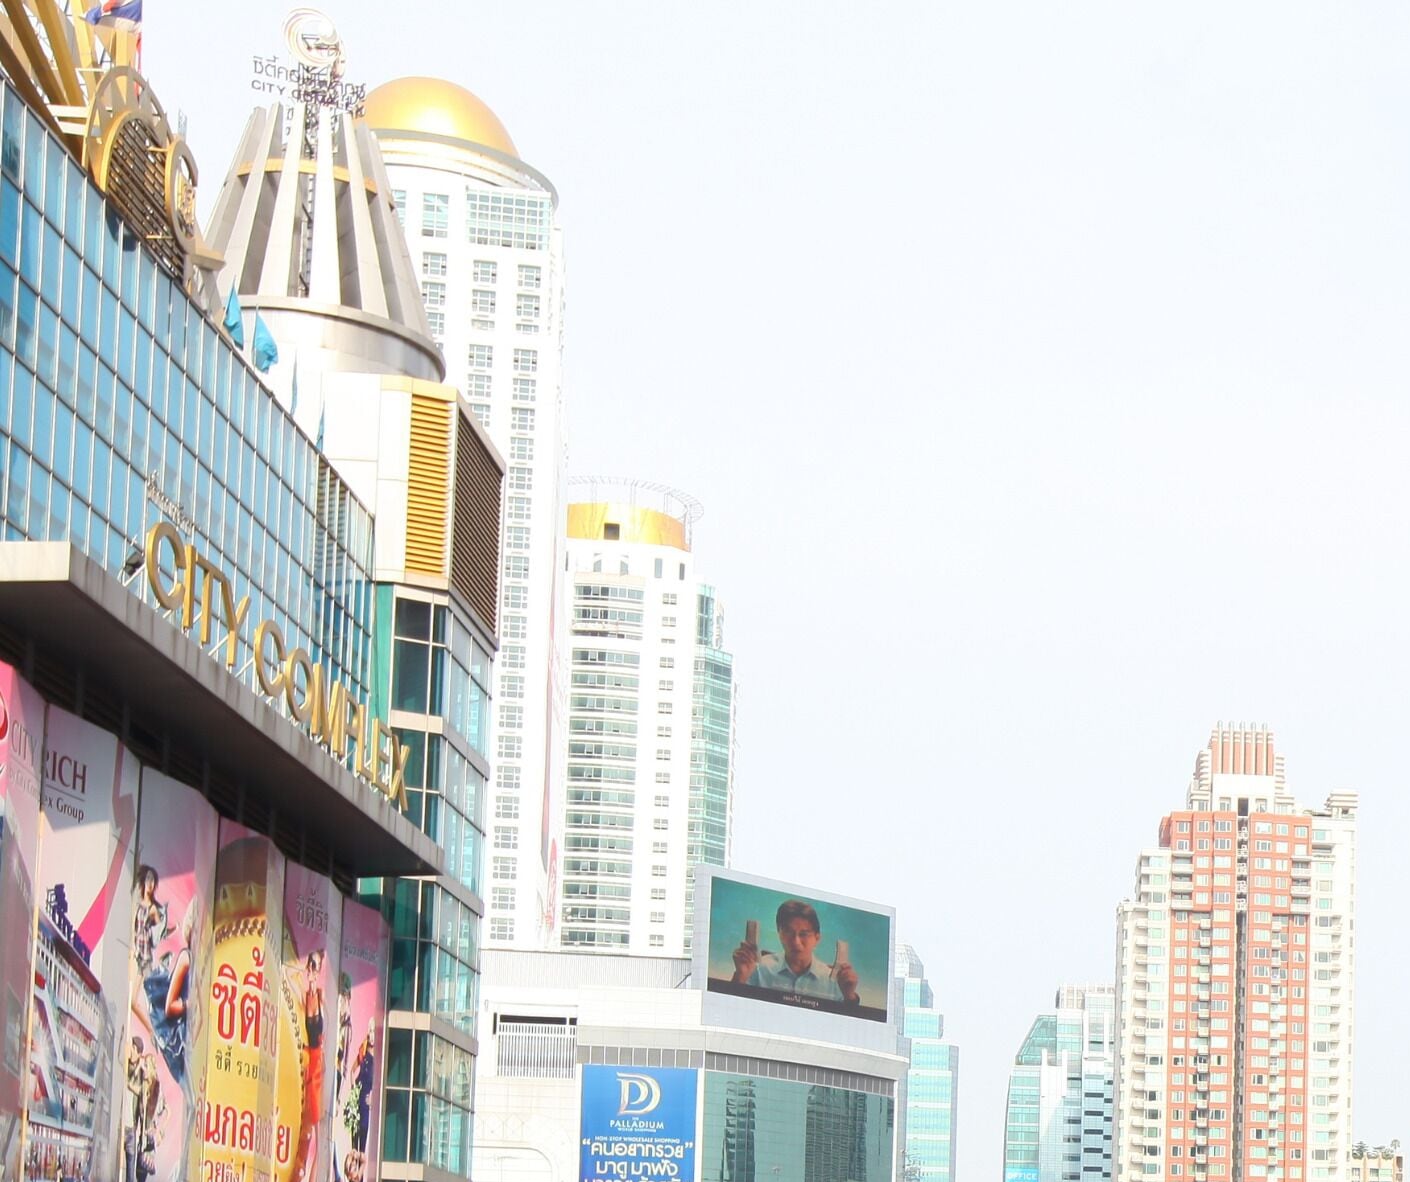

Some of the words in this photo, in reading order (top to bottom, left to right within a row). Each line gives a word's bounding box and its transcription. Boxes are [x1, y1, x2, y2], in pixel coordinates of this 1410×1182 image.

[251, 80, 286, 95] CITY
[146, 521, 249, 667] CITY
[254, 619, 409, 812] COMPLEX
[11, 719, 38, 768] CITY
[56, 797, 85, 823] Group
[610, 1120, 664, 1129] PALLADIUM
[596, 1161, 627, 1179] มาดู
[631, 1159, 678, 1176] มาฟัง
[1007, 1172, 1037, 1180] OFFICE
